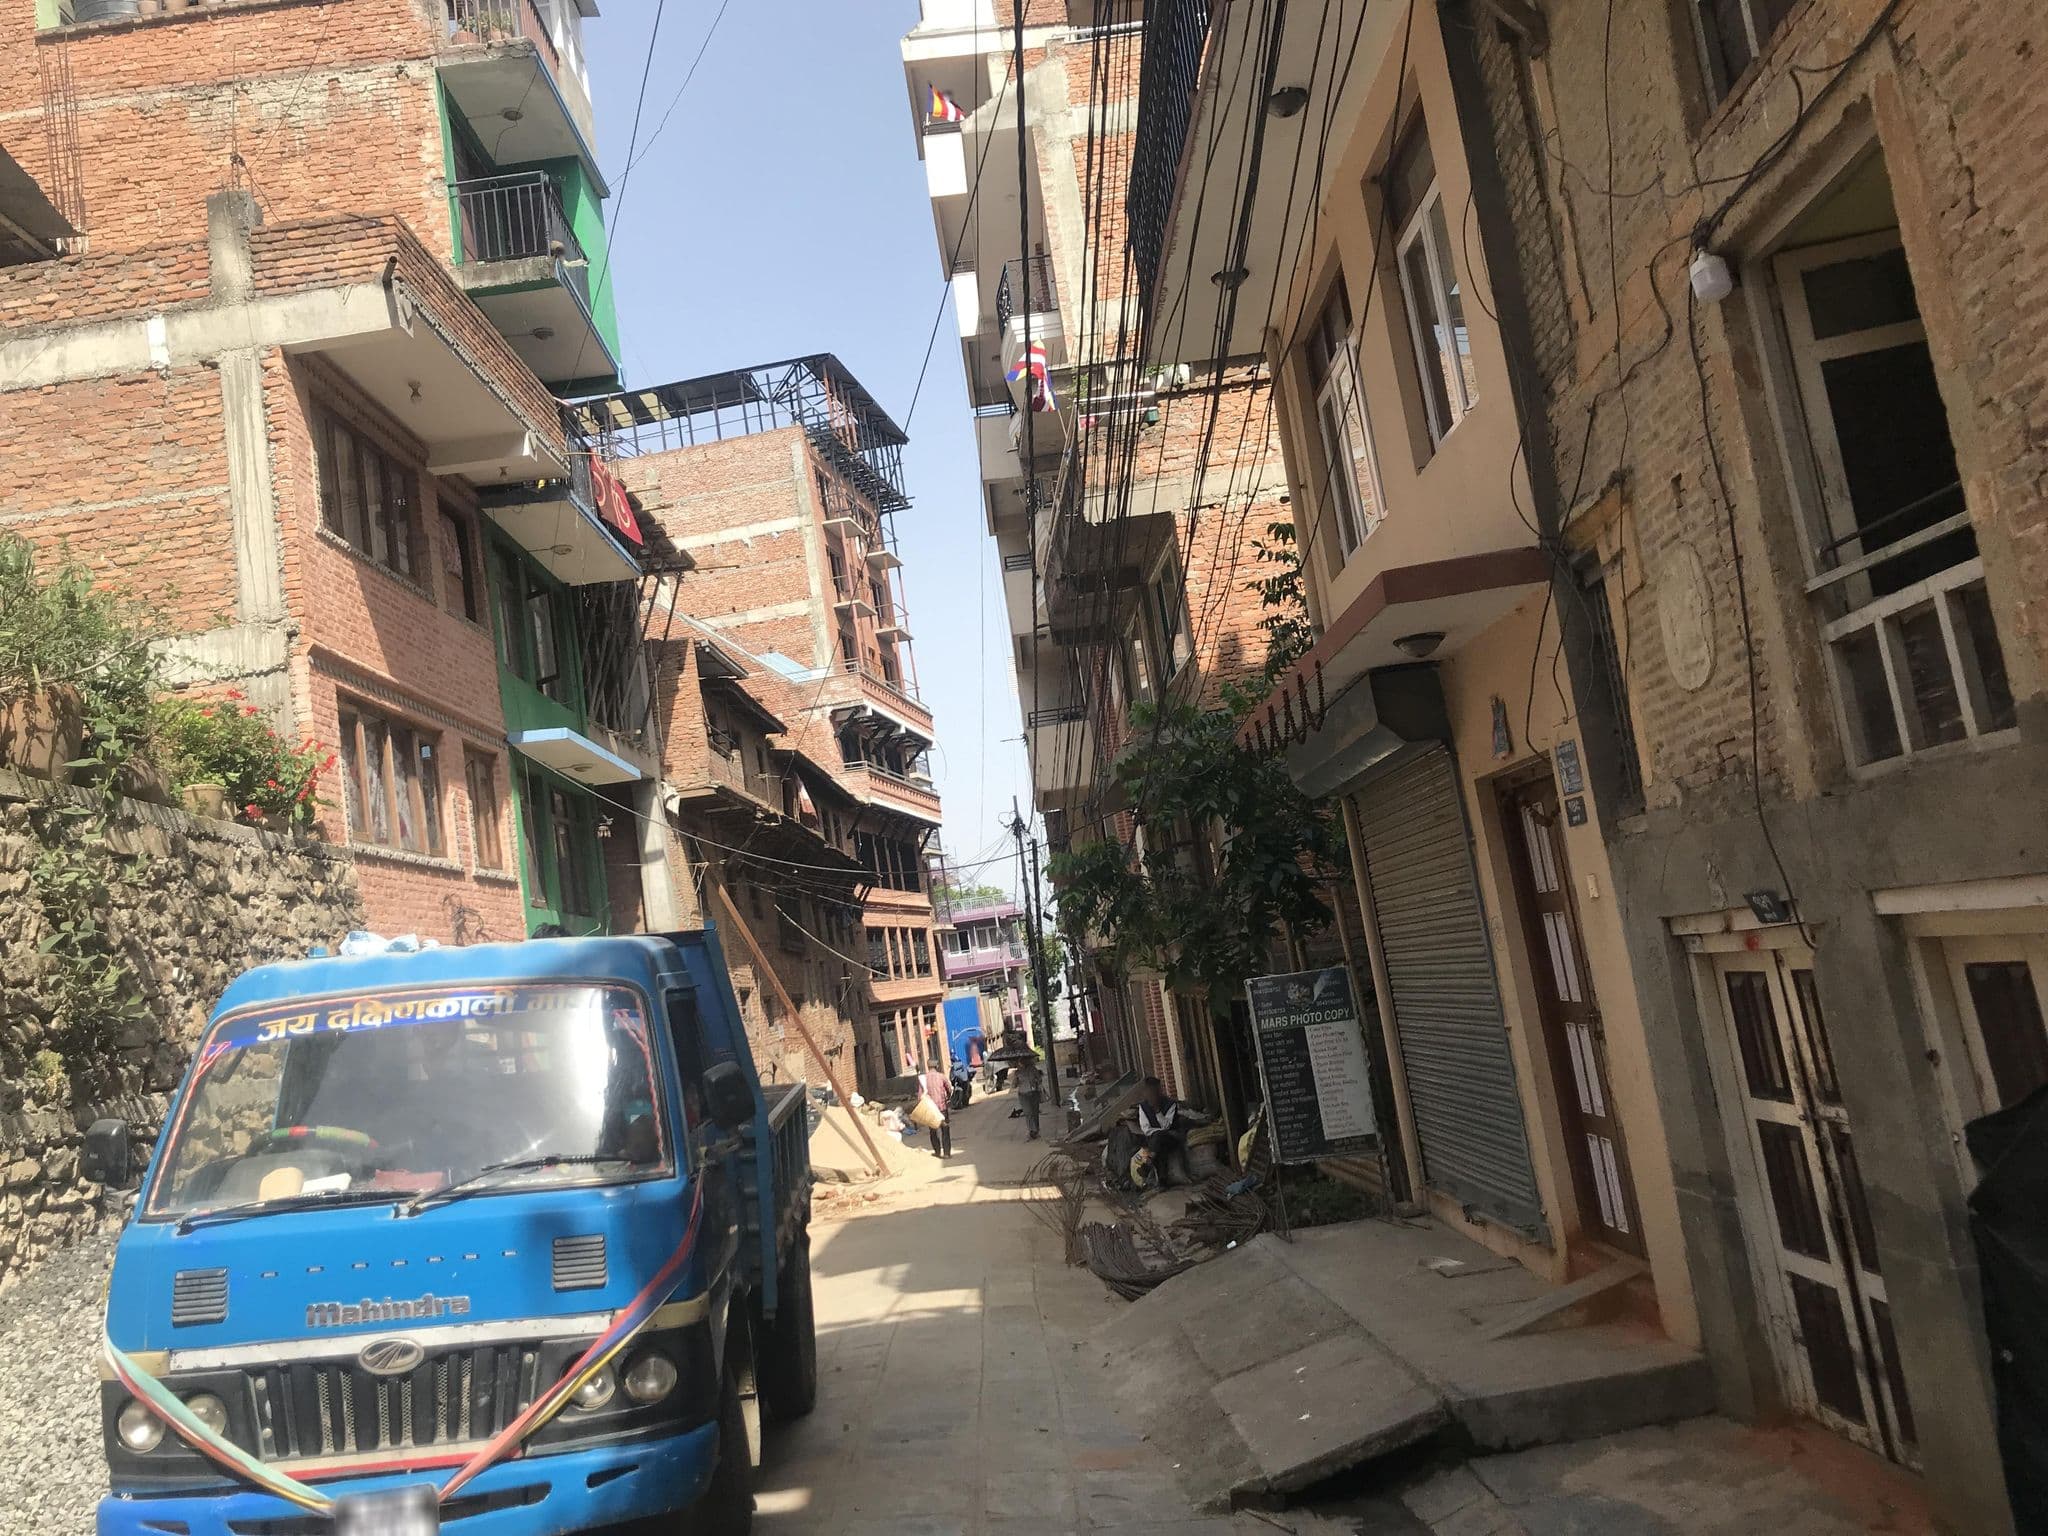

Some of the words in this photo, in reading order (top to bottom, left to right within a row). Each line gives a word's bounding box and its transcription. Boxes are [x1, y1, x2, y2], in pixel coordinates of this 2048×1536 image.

[257, 1013, 320, 1042] जय
[1261, 1017, 1288, 1031] MARS
[1290, 1012, 1323, 1026] PHOTO
[1324, 1008, 1351, 1021] COPY
[306, 1292, 471, 1328] Mahindra
